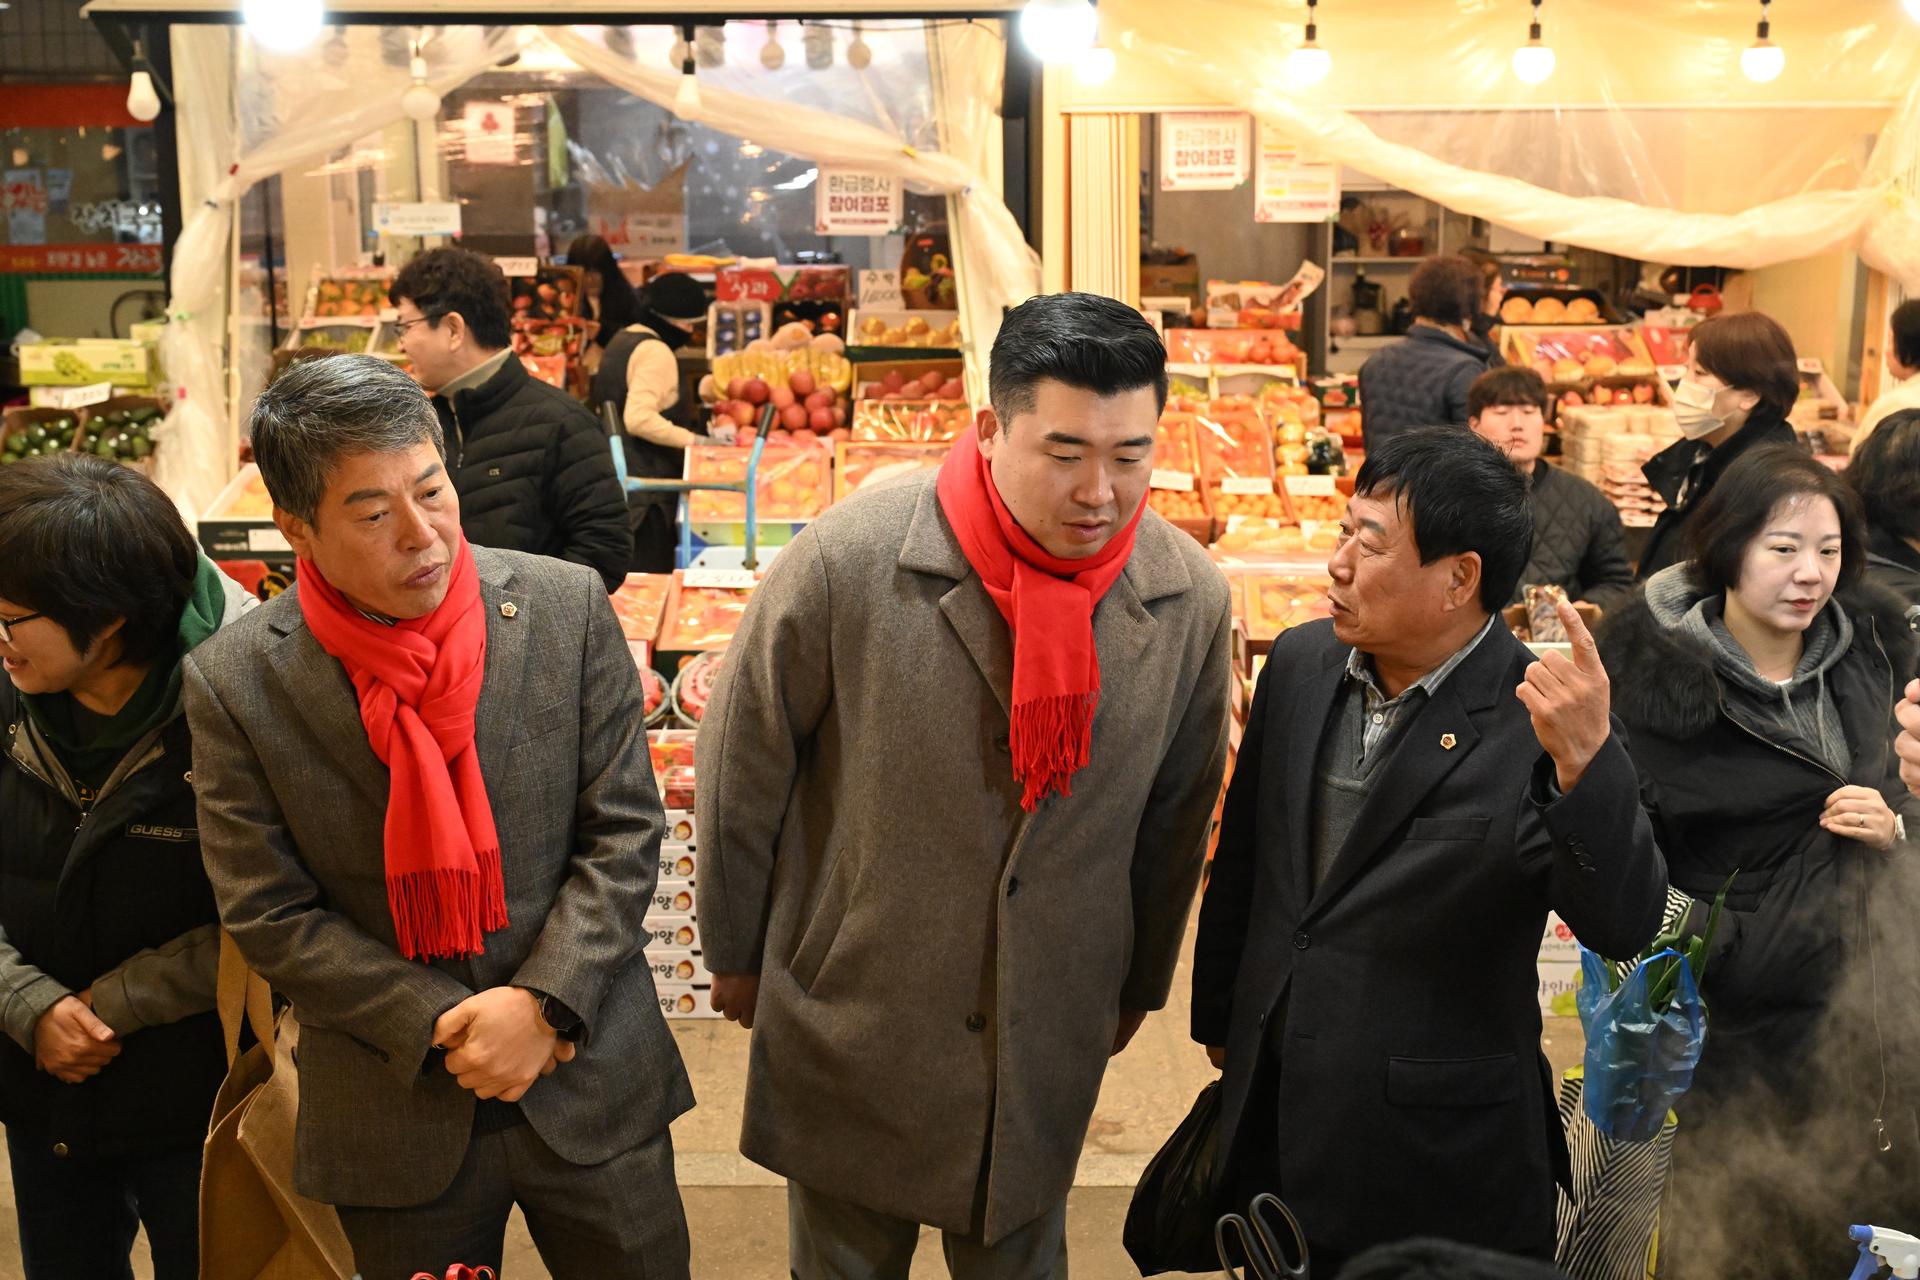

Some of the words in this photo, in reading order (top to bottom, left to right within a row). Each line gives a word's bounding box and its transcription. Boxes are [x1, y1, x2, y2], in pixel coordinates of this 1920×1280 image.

[1175, 149, 1237, 167] 참여점포
[829, 175, 891, 193] 환급행사
[829, 196, 890, 213] 참여점포
[730, 280, 769, 297] 사과
[130, 824, 183, 838] GUESS
